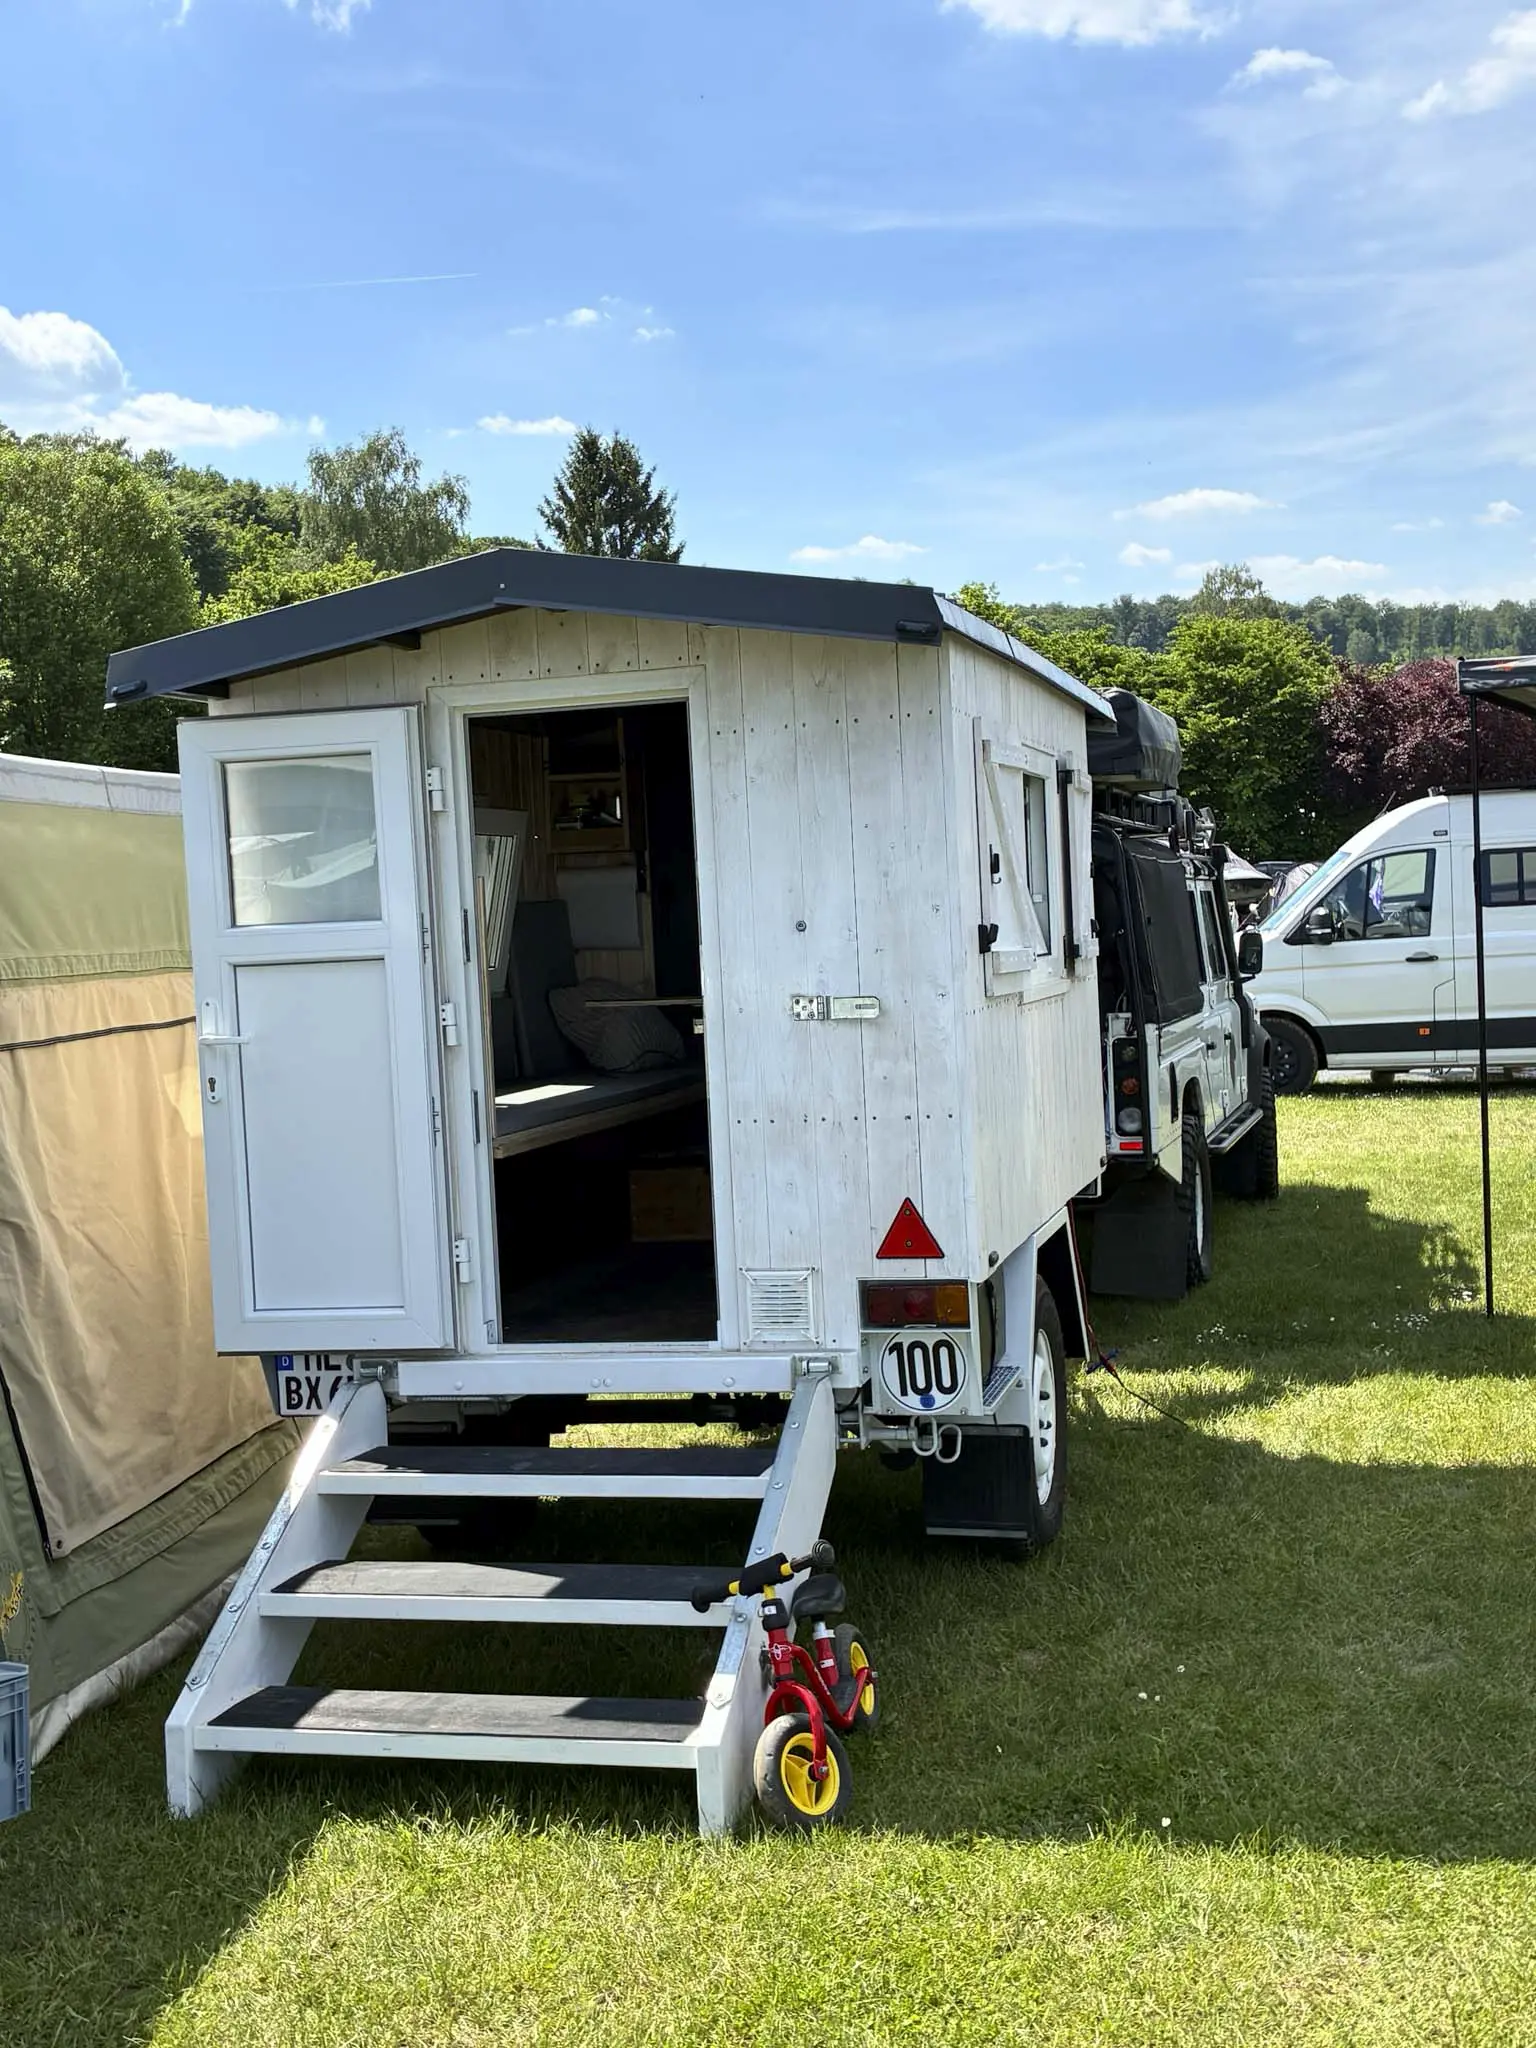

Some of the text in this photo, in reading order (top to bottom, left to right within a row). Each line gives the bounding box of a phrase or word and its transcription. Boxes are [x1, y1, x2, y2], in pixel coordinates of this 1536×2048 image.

[282, 1356, 290, 1367] D
[888, 1339, 959, 1397] 100
[285, 1376, 323, 1410] BX
